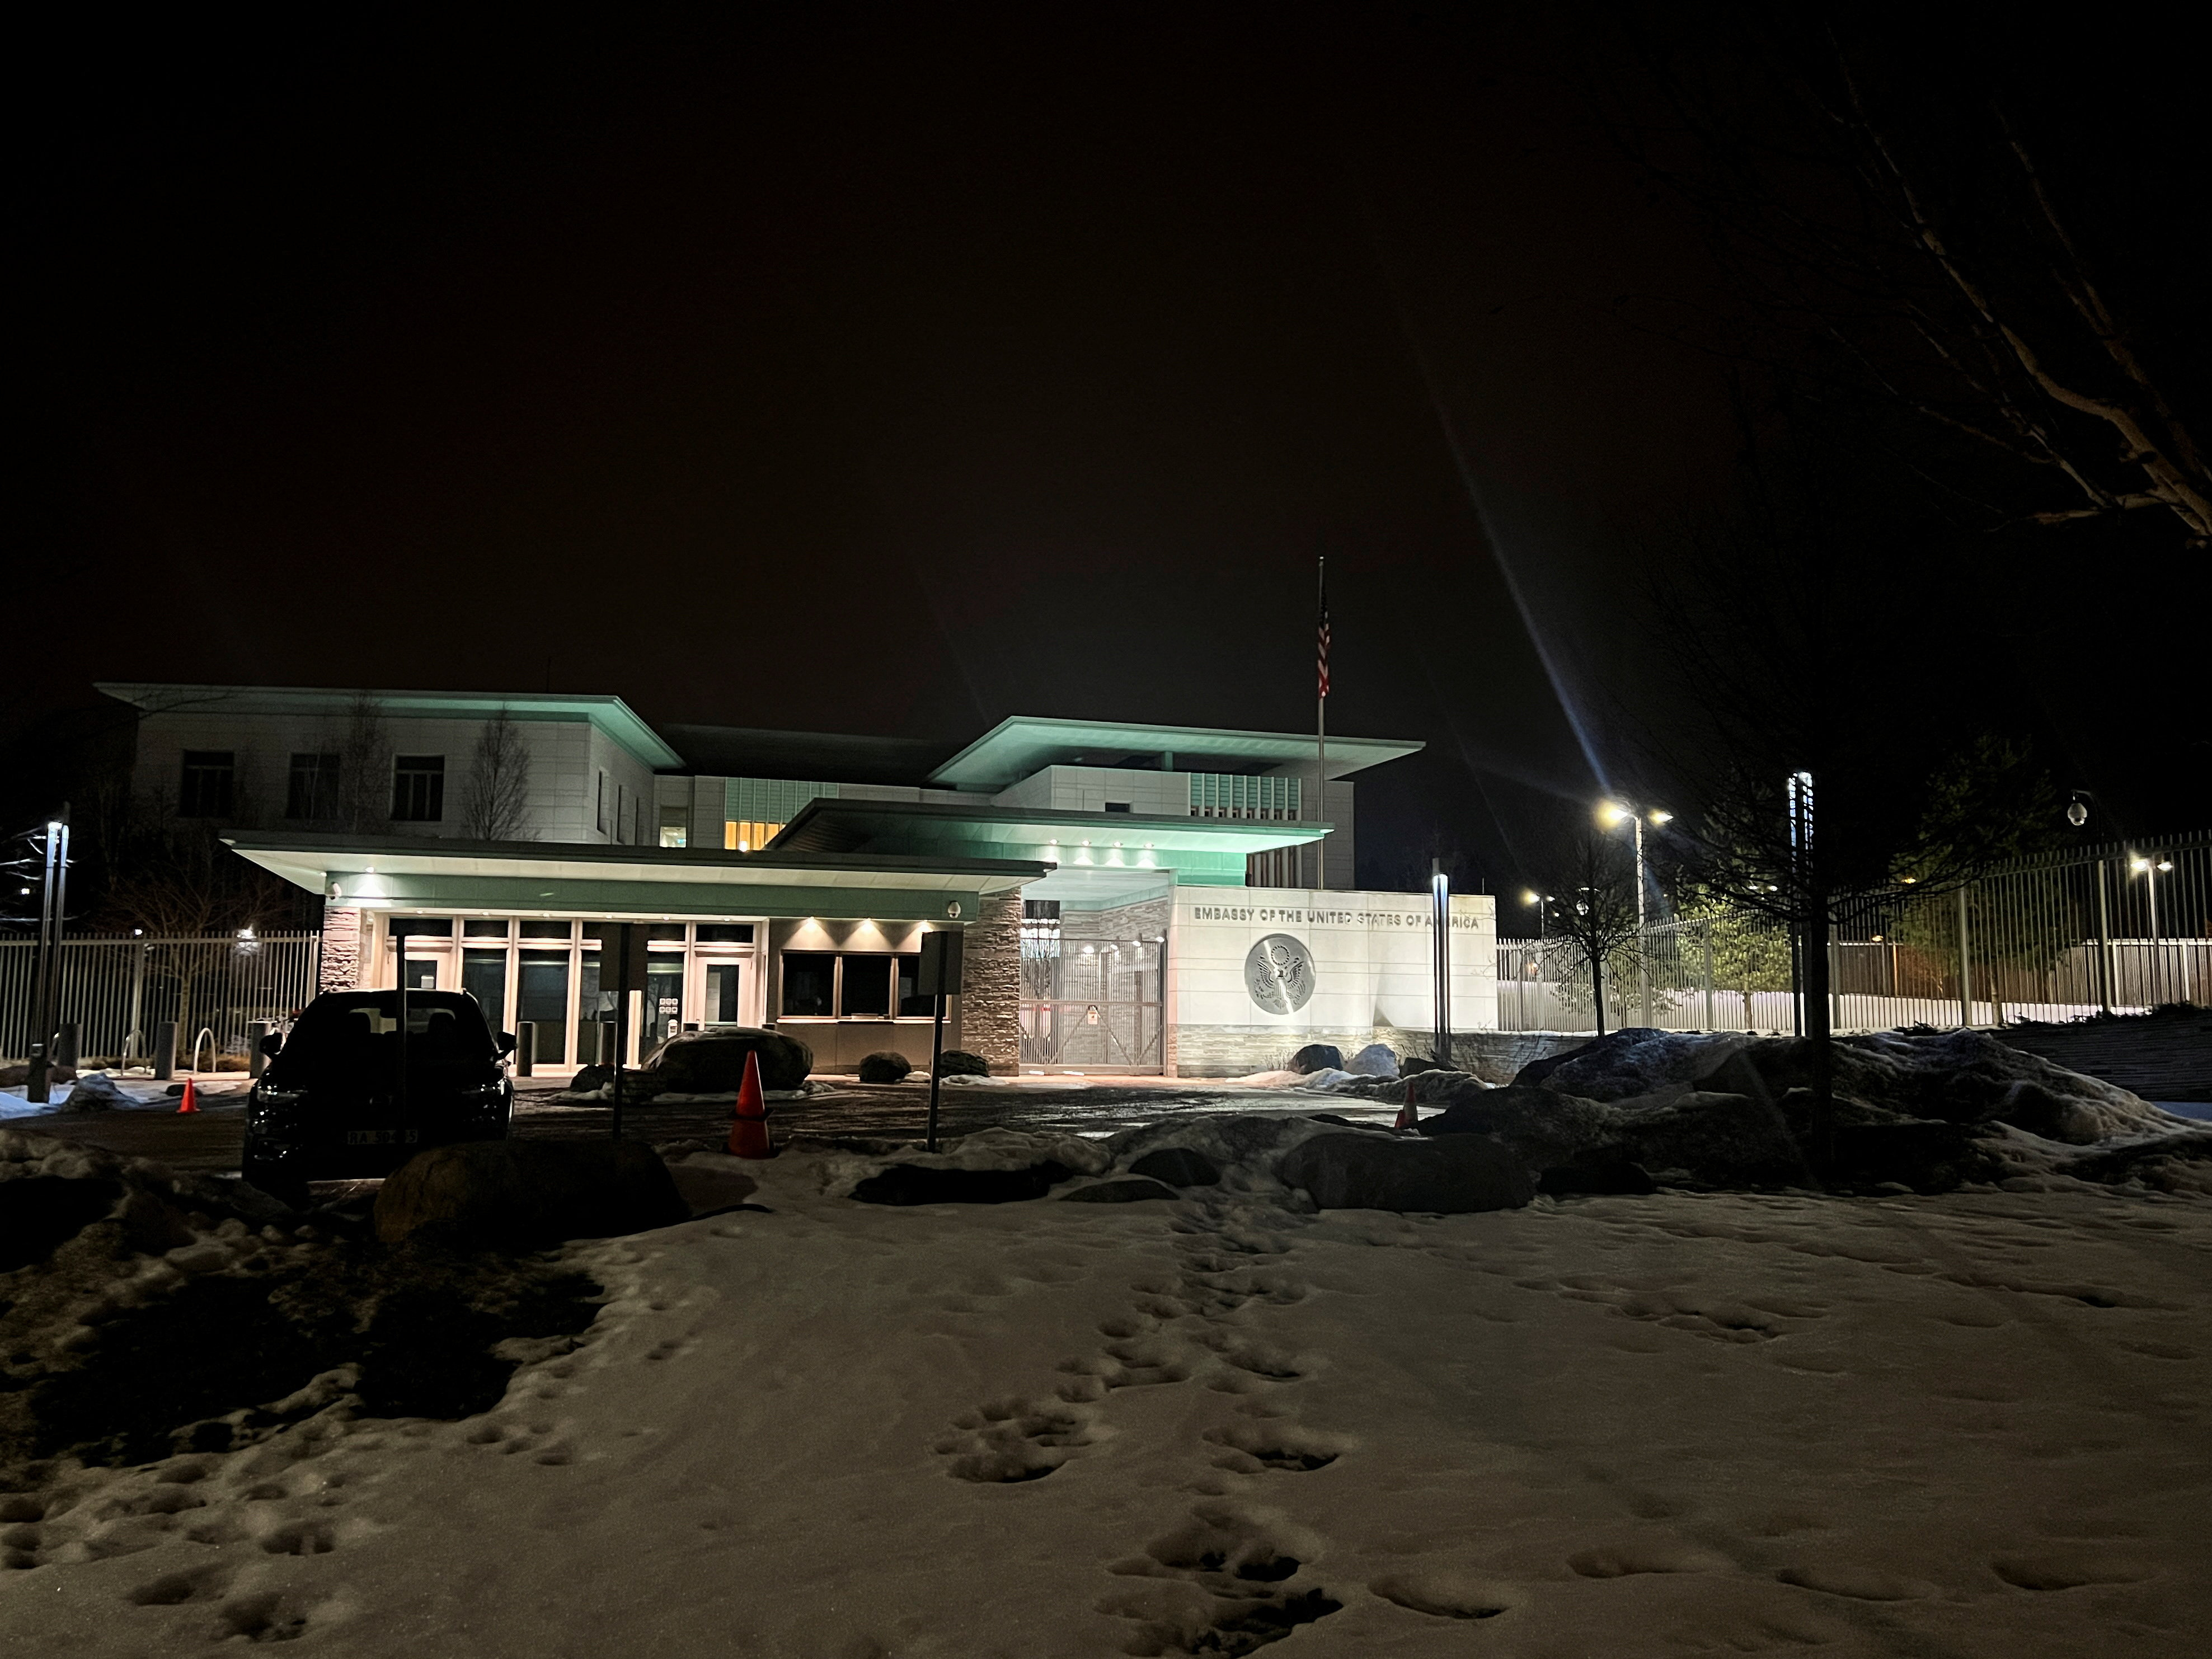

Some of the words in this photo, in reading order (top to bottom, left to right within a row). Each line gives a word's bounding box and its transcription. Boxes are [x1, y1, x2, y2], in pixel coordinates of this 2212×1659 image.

[1195, 907, 1254, 921] EMBASSY
[1260, 909, 1275, 922] OF
[1279, 910, 1302, 923] THE
[1307, 910, 1352, 924] UNITED
[1357, 913, 1401, 927] STATES
[1406, 915, 1421, 928] OF
[1425, 915, 1478, 929] ARICA
